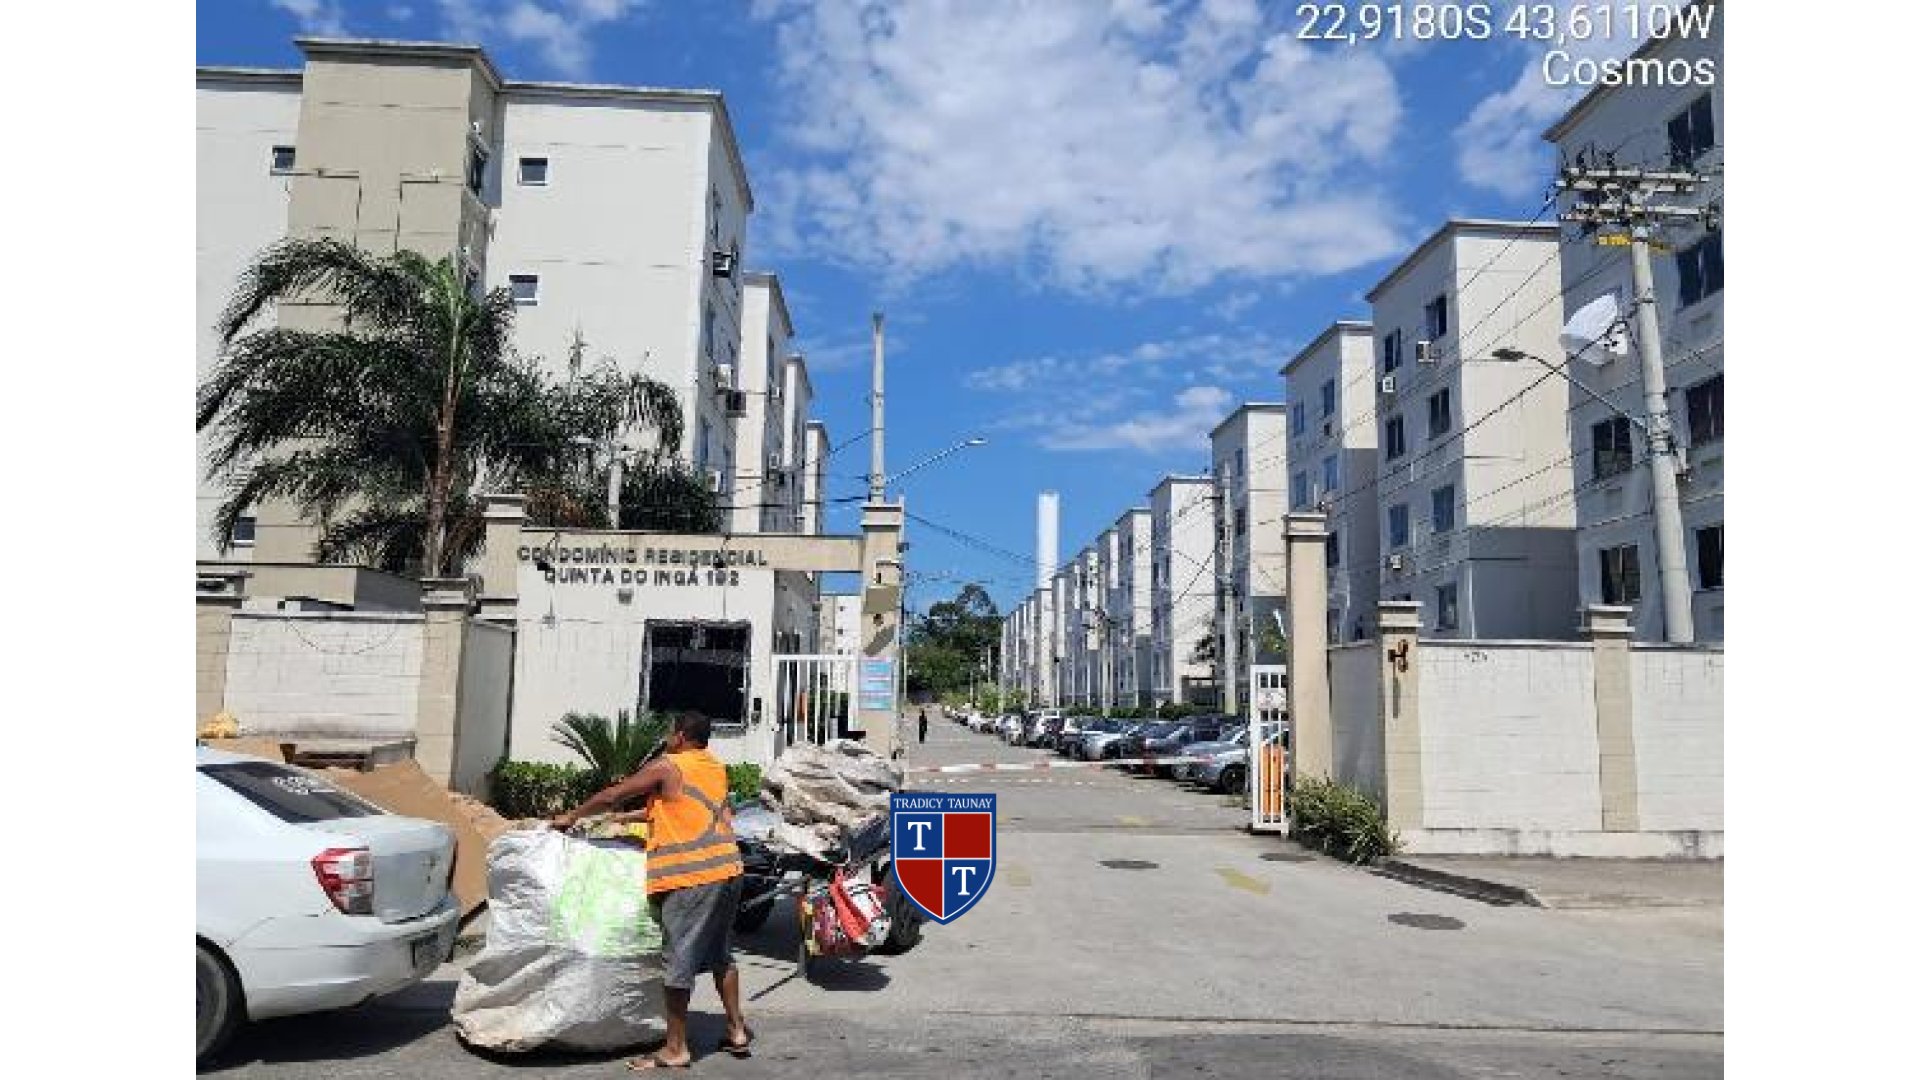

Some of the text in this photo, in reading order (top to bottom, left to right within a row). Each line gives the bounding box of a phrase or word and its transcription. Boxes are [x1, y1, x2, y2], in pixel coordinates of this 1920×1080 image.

[644, 547, 768, 567] RESIDENCIAL
[544, 567, 615, 585] QUINTA
[620, 569, 648, 584] DO
